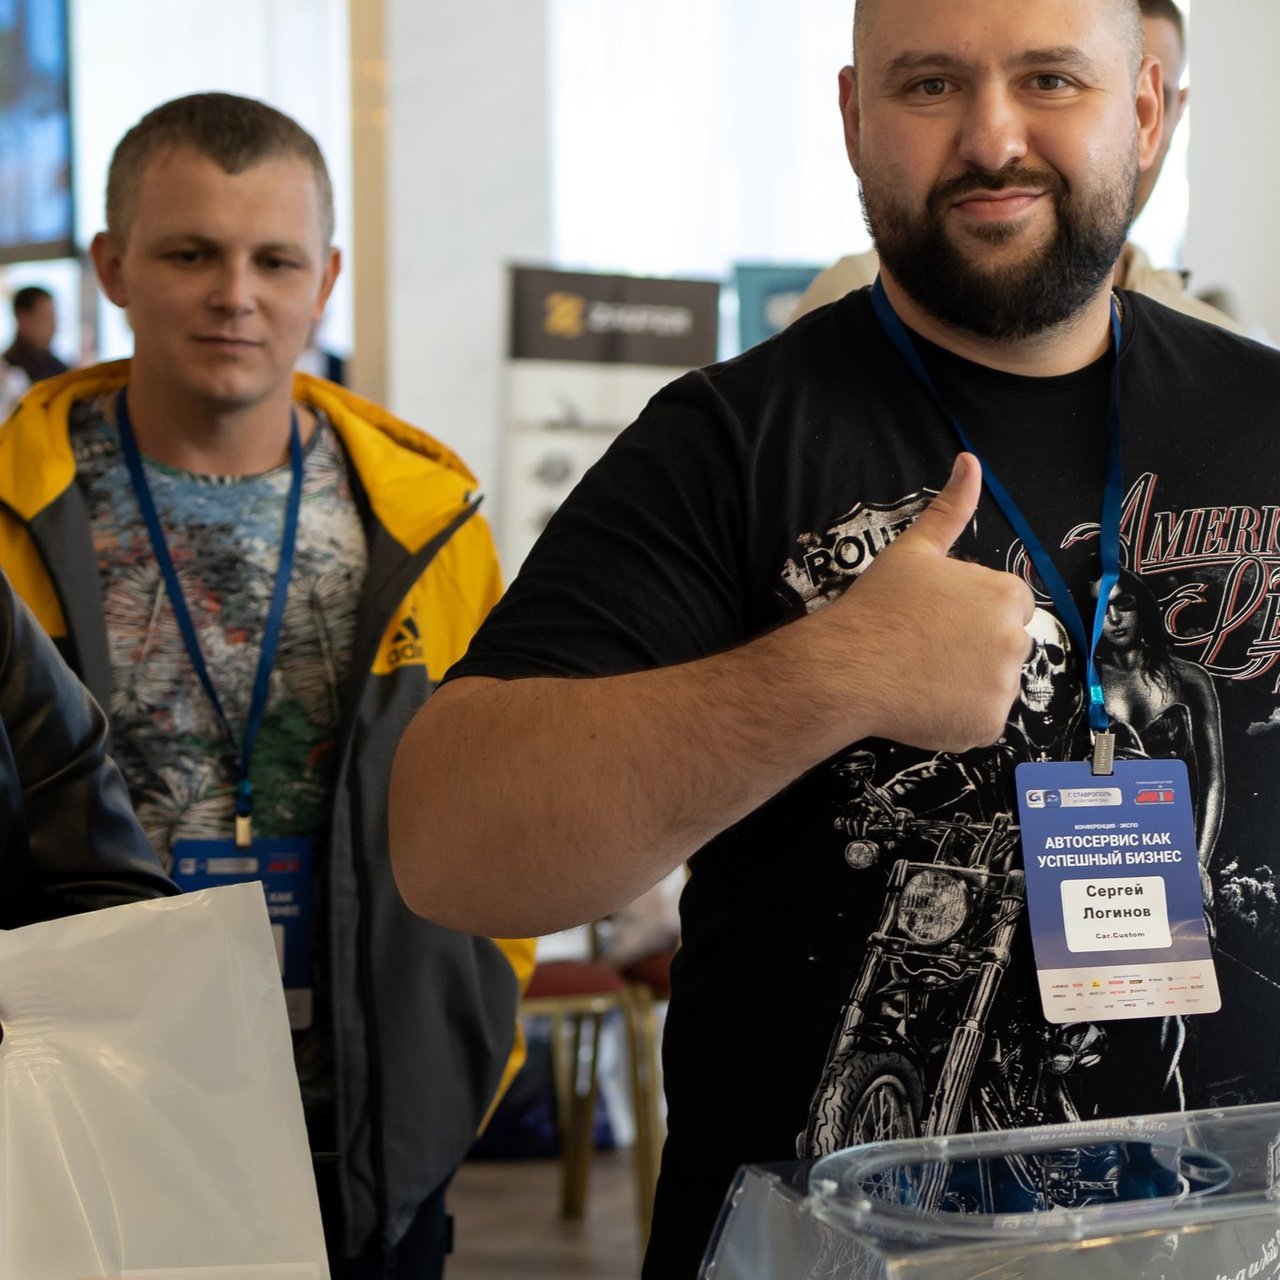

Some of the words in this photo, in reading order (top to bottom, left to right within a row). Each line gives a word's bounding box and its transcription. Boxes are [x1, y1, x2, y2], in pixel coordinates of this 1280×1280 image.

[803, 516, 920, 588] ROUT
[1045, 833, 1139, 849] АВТОСЕРВИС
[1142, 832, 1172, 845] КАК
[1037, 850, 1122, 868] УСПЕШНЫЙ
[1125, 850, 1182, 864] БИЗНЕС
[1086, 883, 1144, 899] Сергей
[1083, 907, 1151, 919] Логинов
